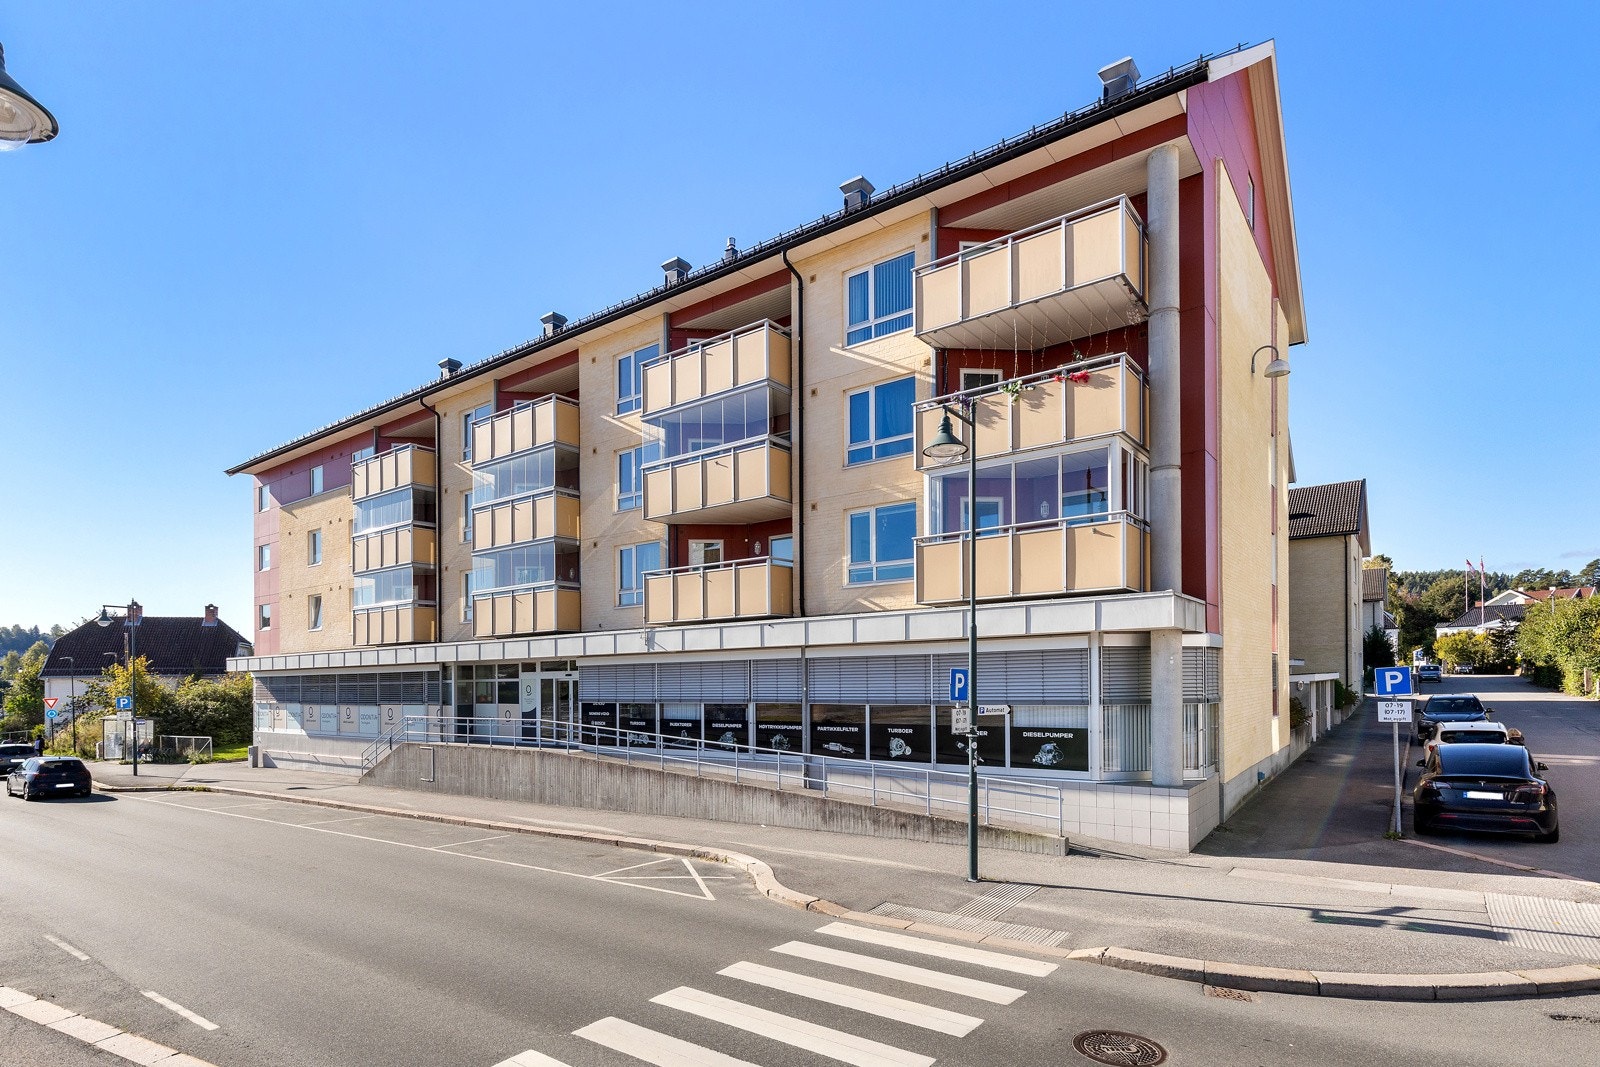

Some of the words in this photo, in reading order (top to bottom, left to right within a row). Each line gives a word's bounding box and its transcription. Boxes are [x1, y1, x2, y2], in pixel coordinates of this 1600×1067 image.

[955, 673, 965, 698] P
[1385, 671, 1403, 692] P
[120, 698, 128, 708] P
